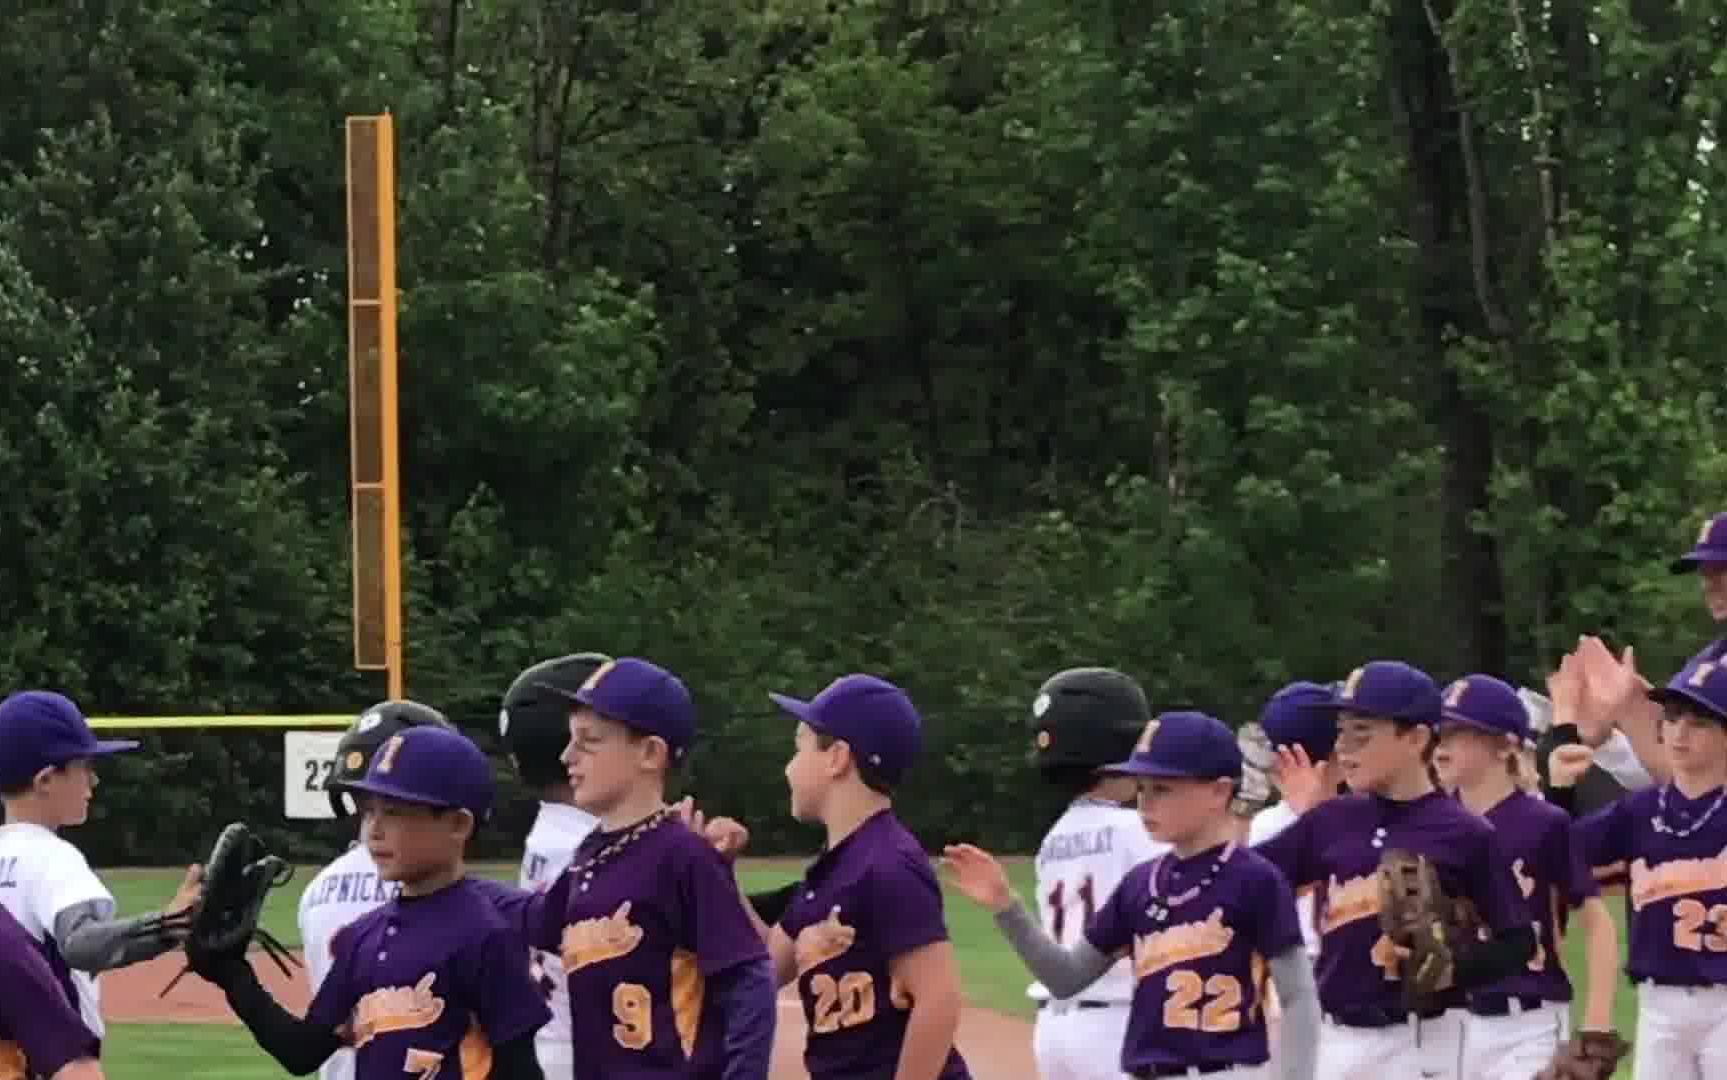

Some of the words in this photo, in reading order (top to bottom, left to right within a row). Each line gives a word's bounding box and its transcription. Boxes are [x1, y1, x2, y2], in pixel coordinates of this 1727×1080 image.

[612, 981, 652, 1050] 9
[810, 970, 875, 1033] 20
[1163, 969, 1242, 1032] 22
